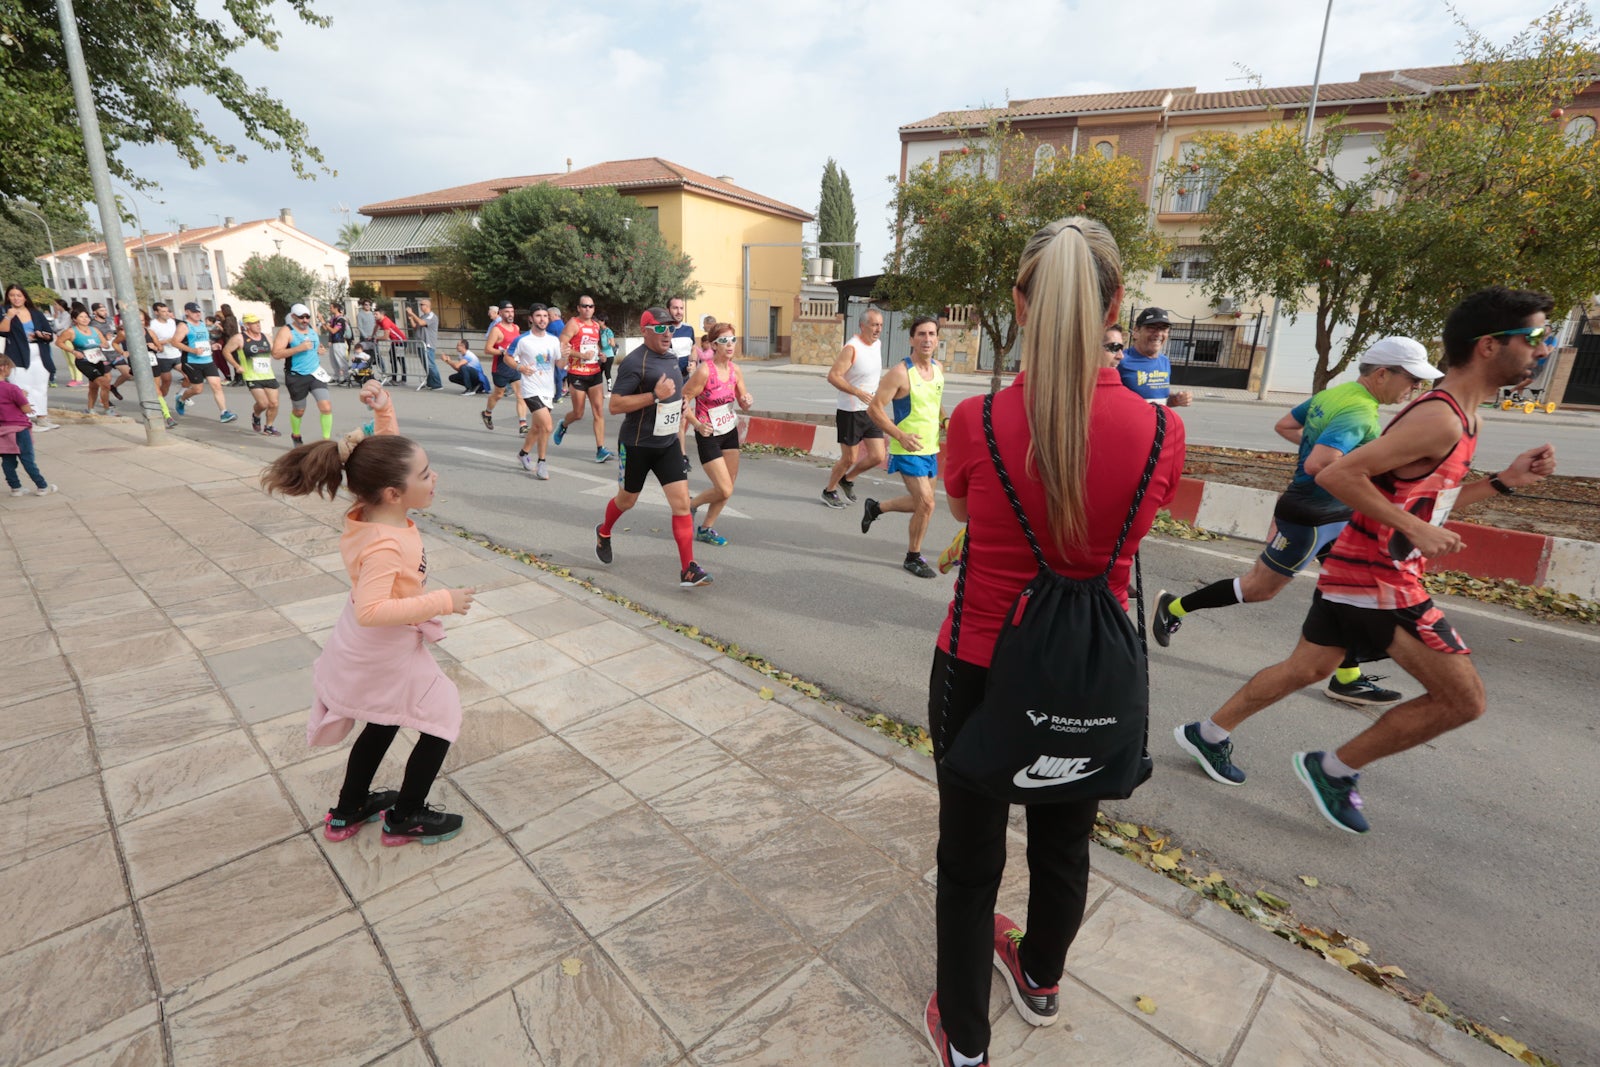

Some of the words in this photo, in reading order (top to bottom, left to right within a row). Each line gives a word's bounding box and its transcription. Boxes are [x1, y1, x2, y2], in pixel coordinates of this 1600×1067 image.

[663, 411, 680, 425] 357
[1051, 715, 1082, 726] RAFA
[1083, 716, 1118, 727] NADAL
[1049, 725, 1090, 734] ACADEMY
[1028, 755, 1092, 778] NIKE
